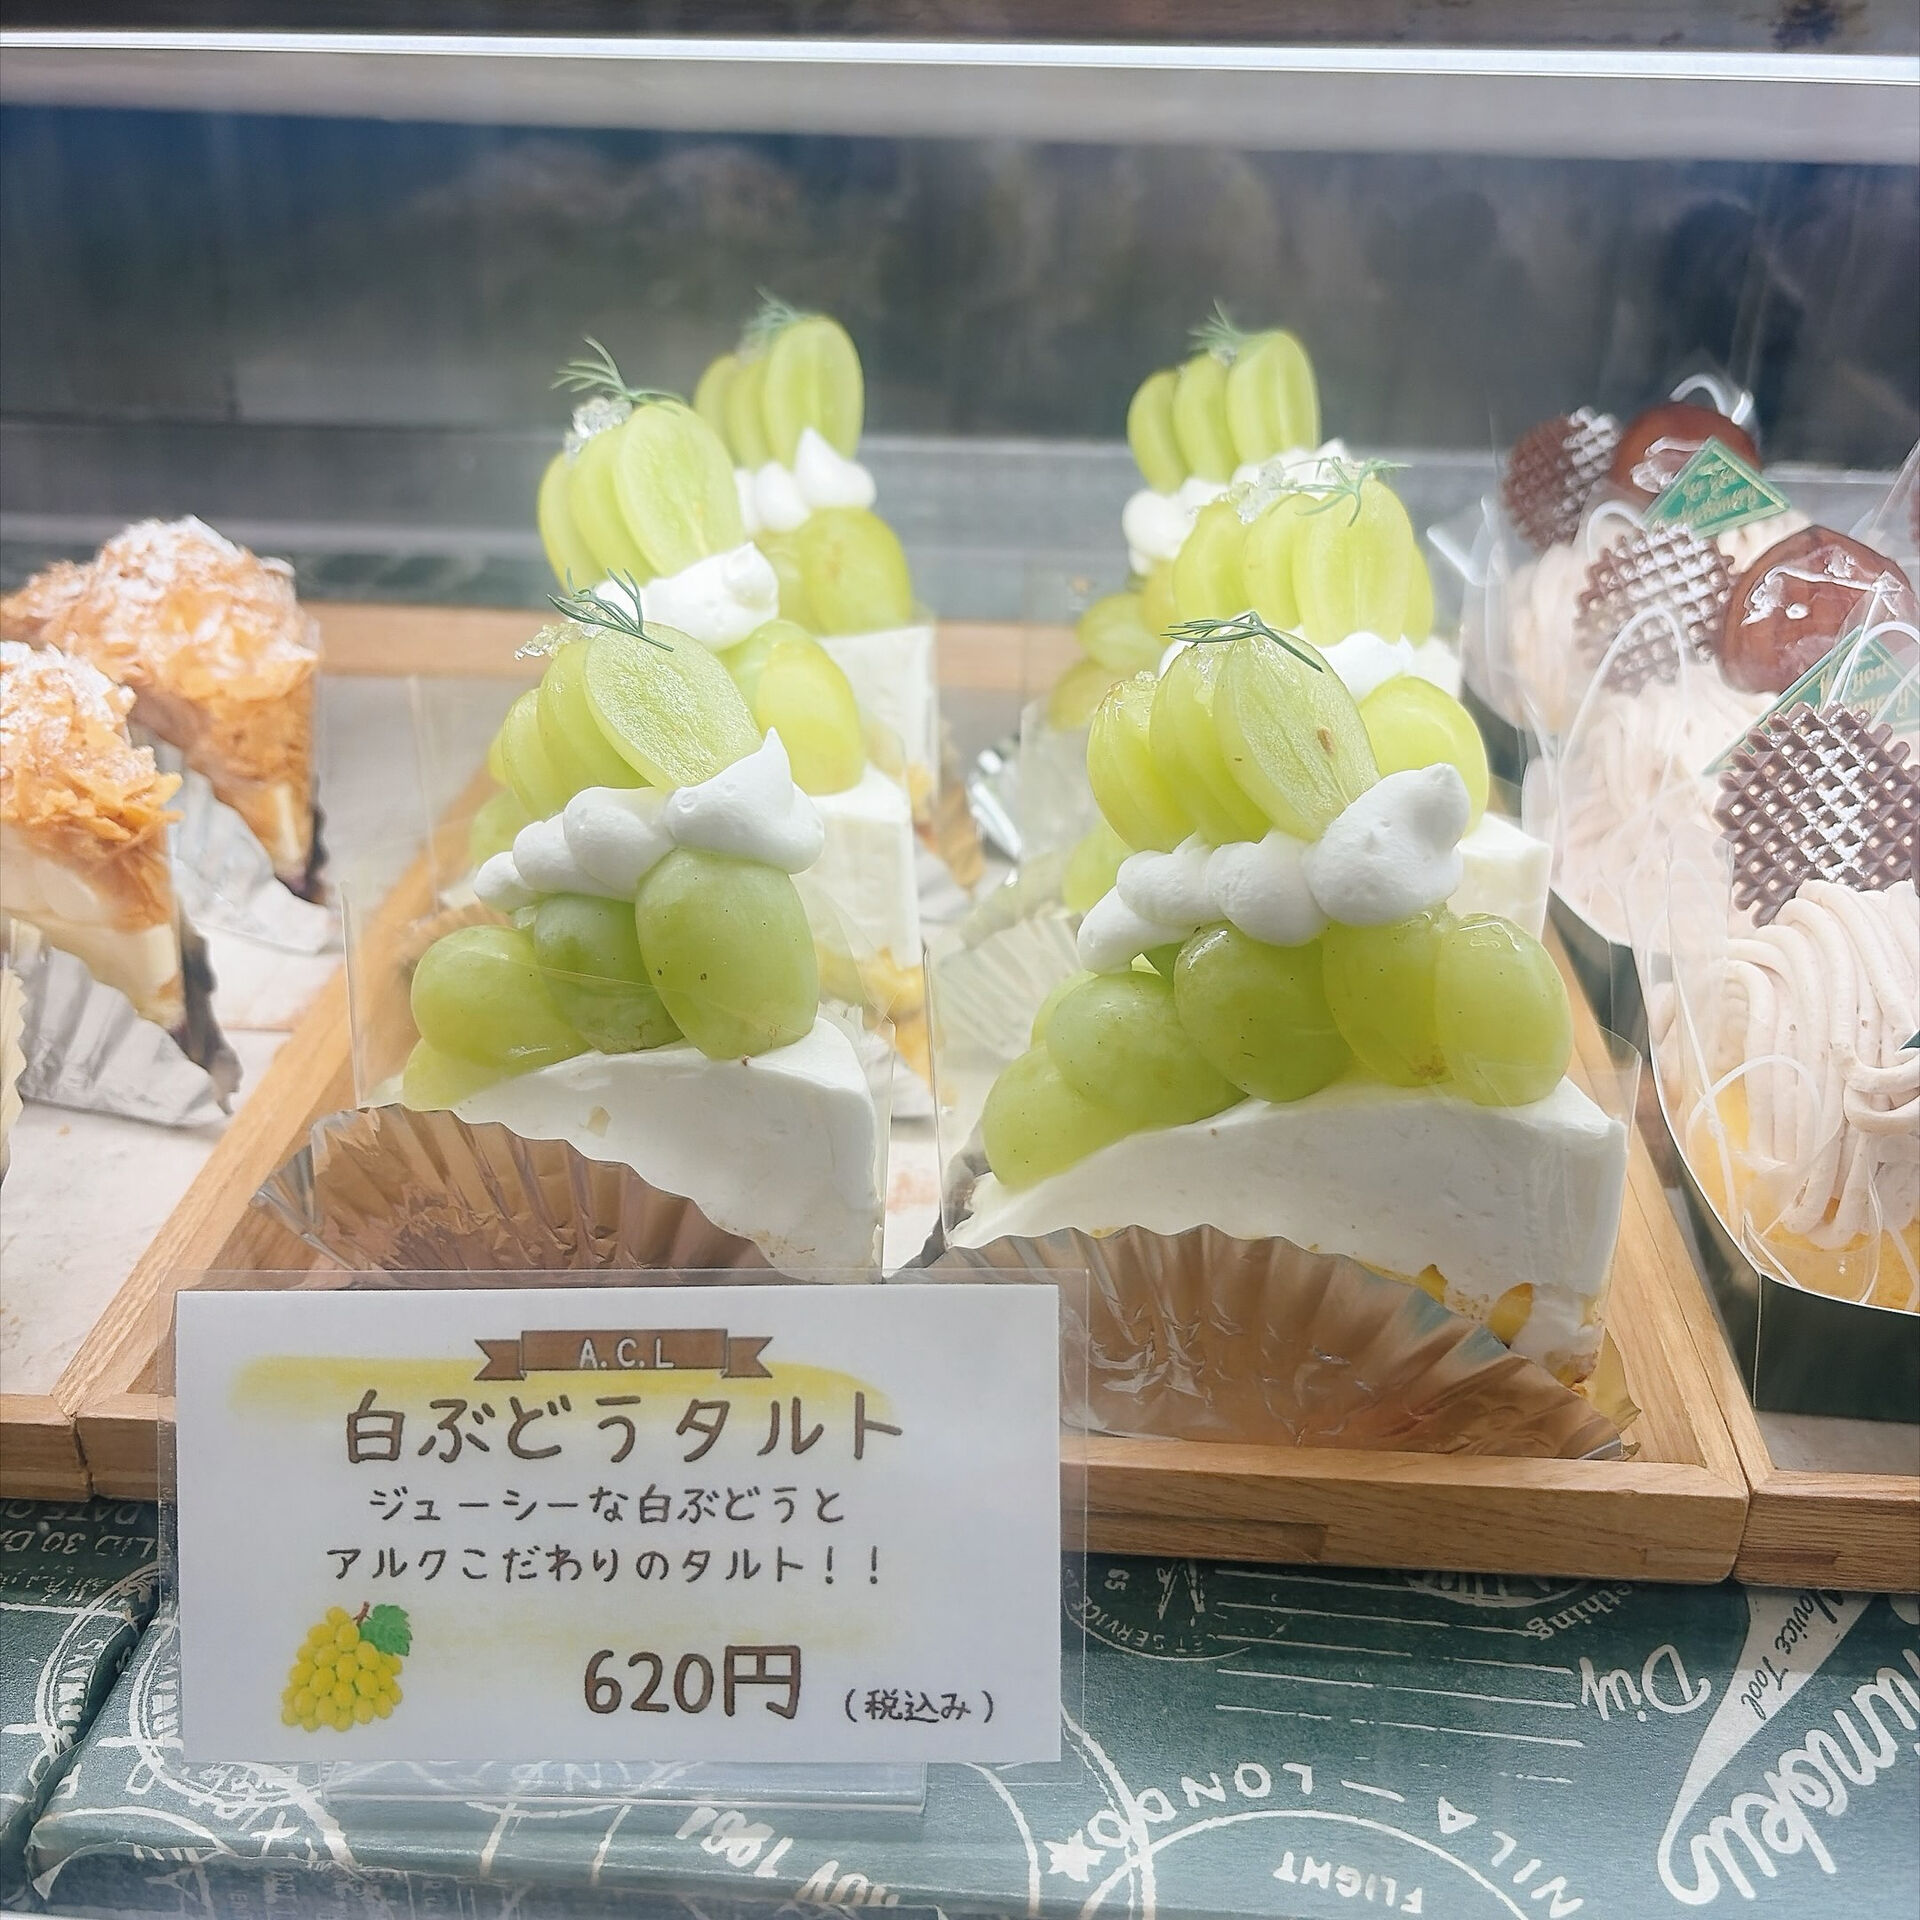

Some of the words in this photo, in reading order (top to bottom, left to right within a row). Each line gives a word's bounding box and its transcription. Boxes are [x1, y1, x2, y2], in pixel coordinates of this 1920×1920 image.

[579, 1336, 675, 1371] A.C.L
[346, 1388, 903, 1465] 白ぶどうタルト
[368, 1484, 846, 1525] ジューシーな白ぶどうと
[326, 1545, 883, 1584] アルクこだわりのタルト！！
[583, 1645, 802, 1719] 620円
[844, 1687, 996, 1725] (税込み)
[1740, 1655, 1791, 1721] Tool
[1273, 1850, 1423, 1915] FLIGHT
